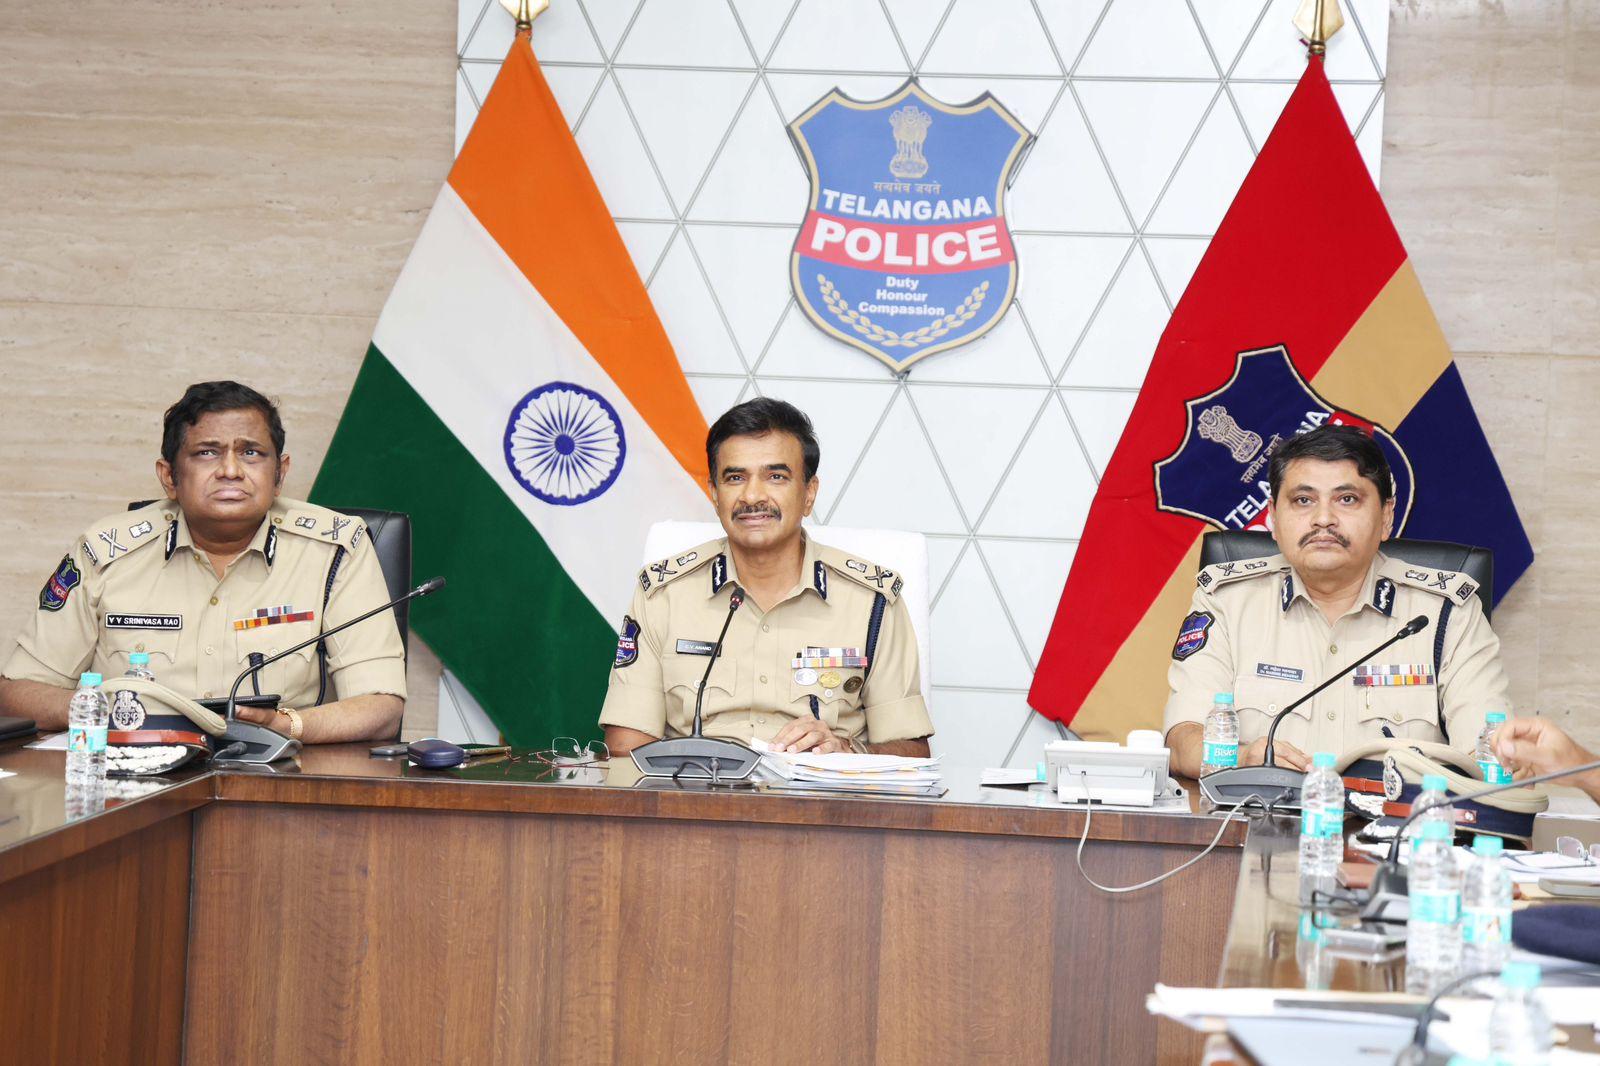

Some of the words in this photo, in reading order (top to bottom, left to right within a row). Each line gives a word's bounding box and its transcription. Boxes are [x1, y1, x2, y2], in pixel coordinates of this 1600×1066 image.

[822, 189, 993, 221] TELANGANA
[810, 217, 1002, 266] POLICE
[886, 276, 919, 291] Duty
[876, 289, 928, 302] Honour
[858, 301, 945, 317] Compassion
[123, 617, 162, 625] SRINIVASA
[163, 618, 179, 626] RAO
